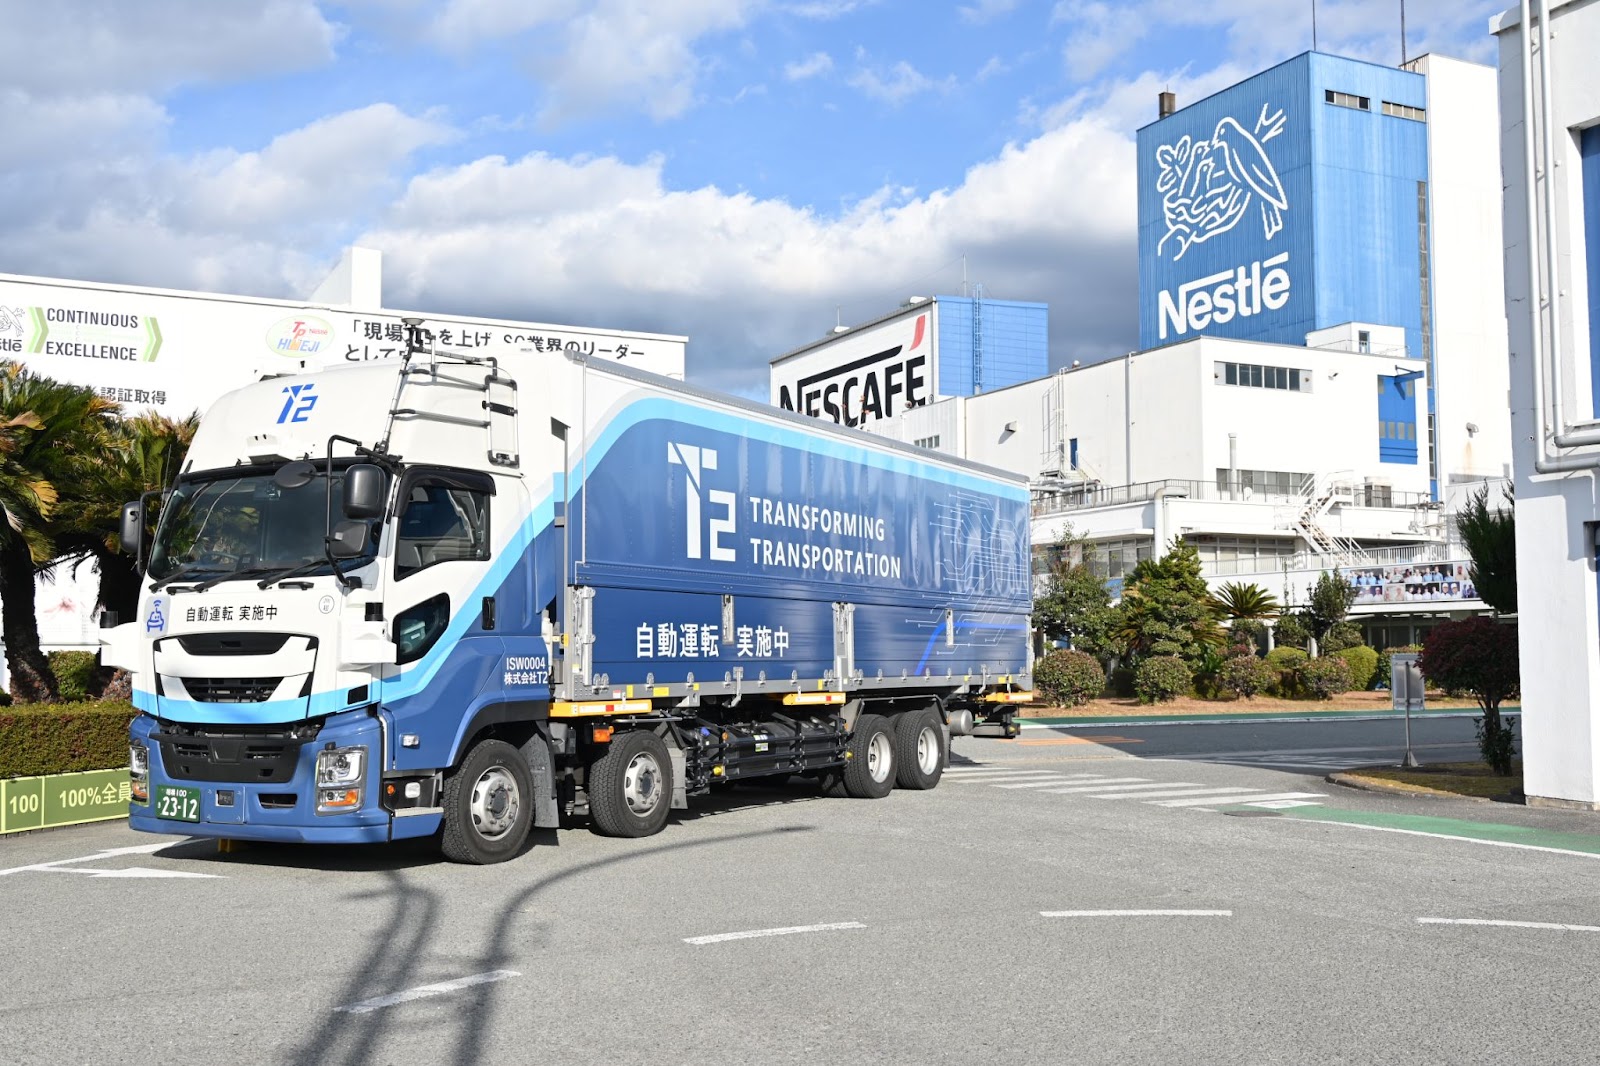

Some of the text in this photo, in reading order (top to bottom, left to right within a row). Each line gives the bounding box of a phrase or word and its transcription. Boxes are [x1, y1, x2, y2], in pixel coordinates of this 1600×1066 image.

[1158, 252, 1291, 340] Nestlé
[46, 307, 139, 328] CONTINUOUS
[46, 341, 138, 361] EXCELLENCE
[276, 383, 319, 424] T2
[667, 441, 737, 562] T2
[750, 496, 885, 542] TRANSFORMING
[750, 538, 901, 580] TRANSPORTATION
[186, 605, 278, 622] 自動運転 実施中
[635, 622, 790, 659] 自動運転 実施中
[506, 656, 546, 671] ISW0004
[504, 671, 549, 686] 株式会社T2
[10, 794, 39, 815] 100
[59, 781, 132, 808] 100%全員
[161, 796, 198, 819] 23-12
